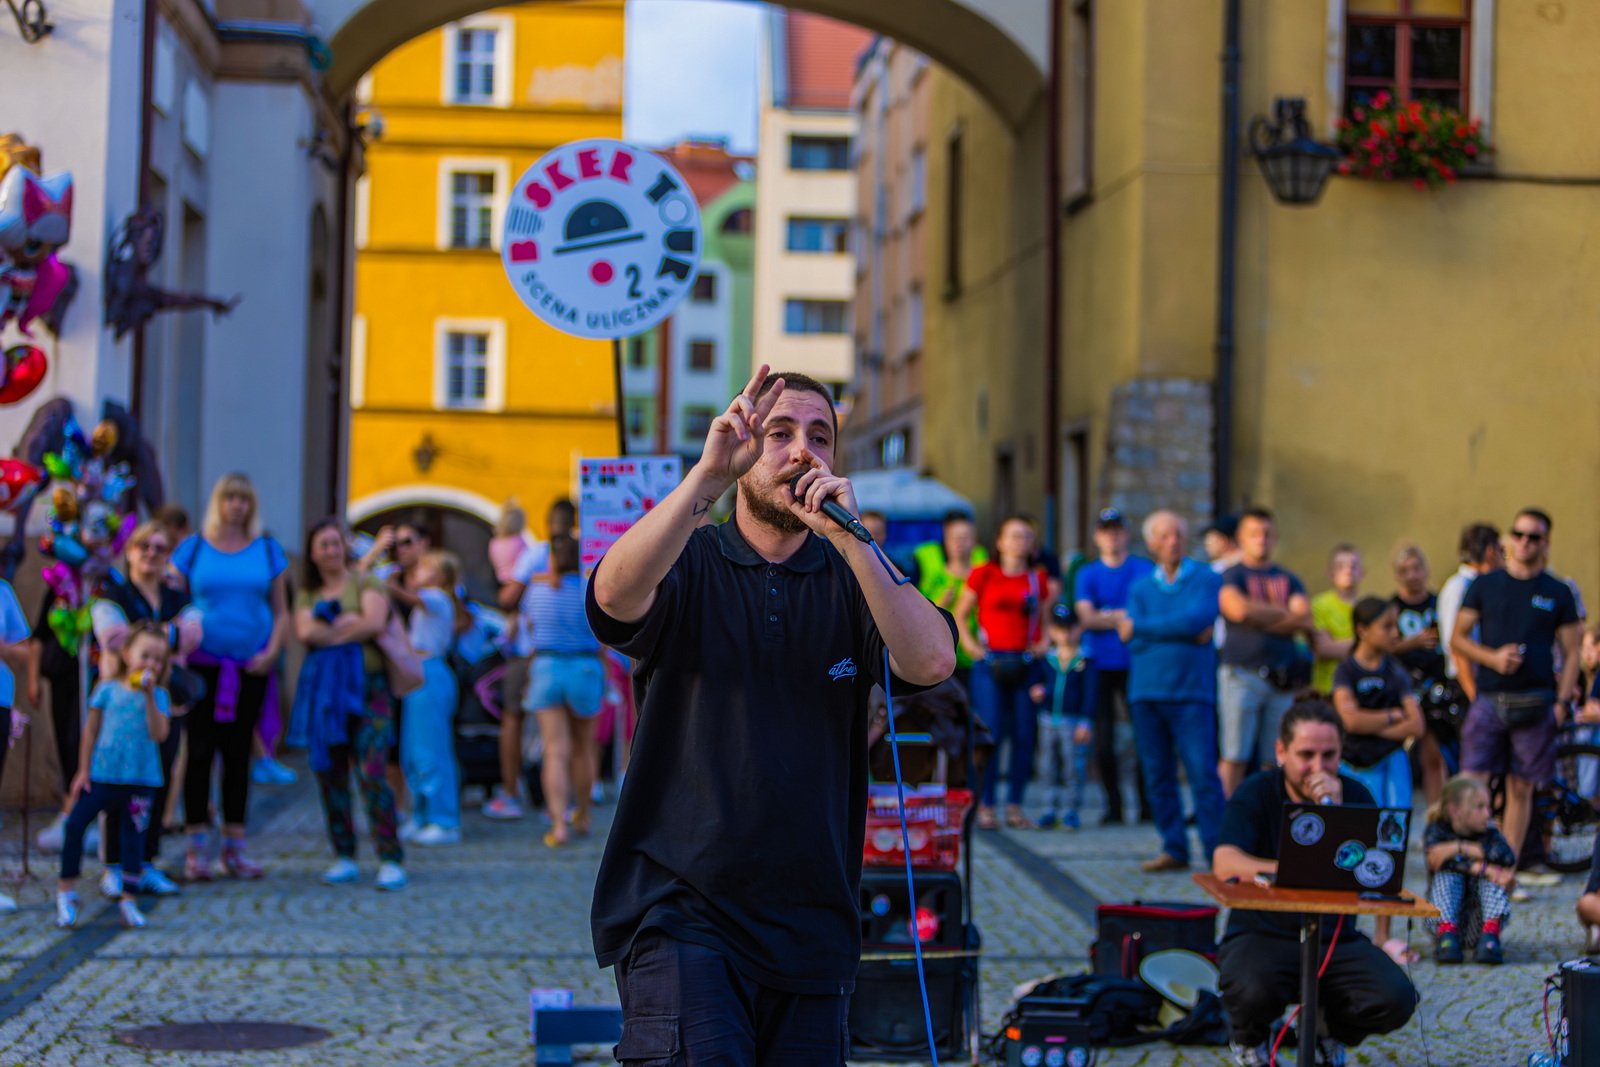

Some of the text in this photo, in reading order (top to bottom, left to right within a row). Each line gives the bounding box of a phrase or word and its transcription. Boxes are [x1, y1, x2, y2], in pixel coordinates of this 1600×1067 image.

[645, 171, 695, 281] TOUR
[521, 270, 671, 329] SCENA ULICZNA
[626, 264, 642, 298] 2
